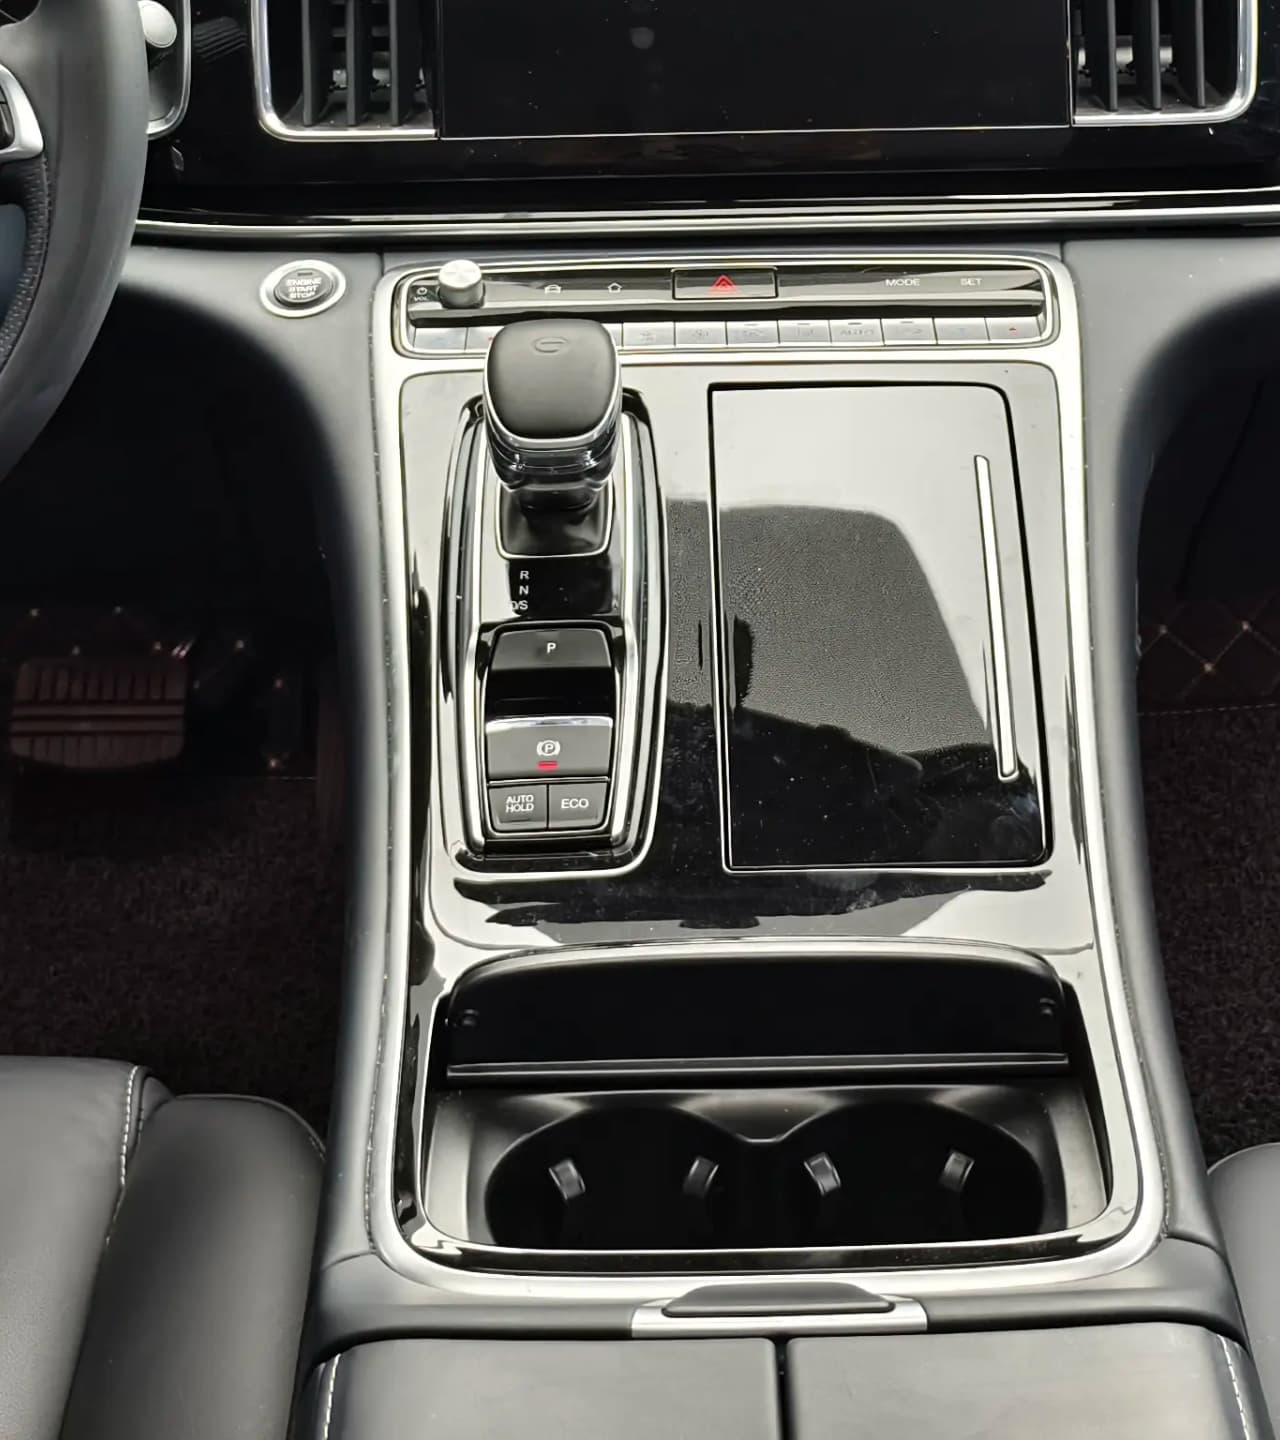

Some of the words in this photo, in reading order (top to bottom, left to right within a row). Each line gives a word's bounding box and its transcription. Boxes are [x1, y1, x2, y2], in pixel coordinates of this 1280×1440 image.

[284, 276, 323, 287] ENGINE
[884, 277, 922, 287] MODE
[959, 276, 983, 287] SET
[287, 284, 320, 293] START
[288, 291, 316, 300] STOP
[519, 569, 531, 581] R
[518, 584, 530, 596] N
[545, 641, 557, 655] P
[505, 793, 535, 805] AUTO
[560, 797, 590, 810] ECO
[504, 803, 535, 814] HOLD
